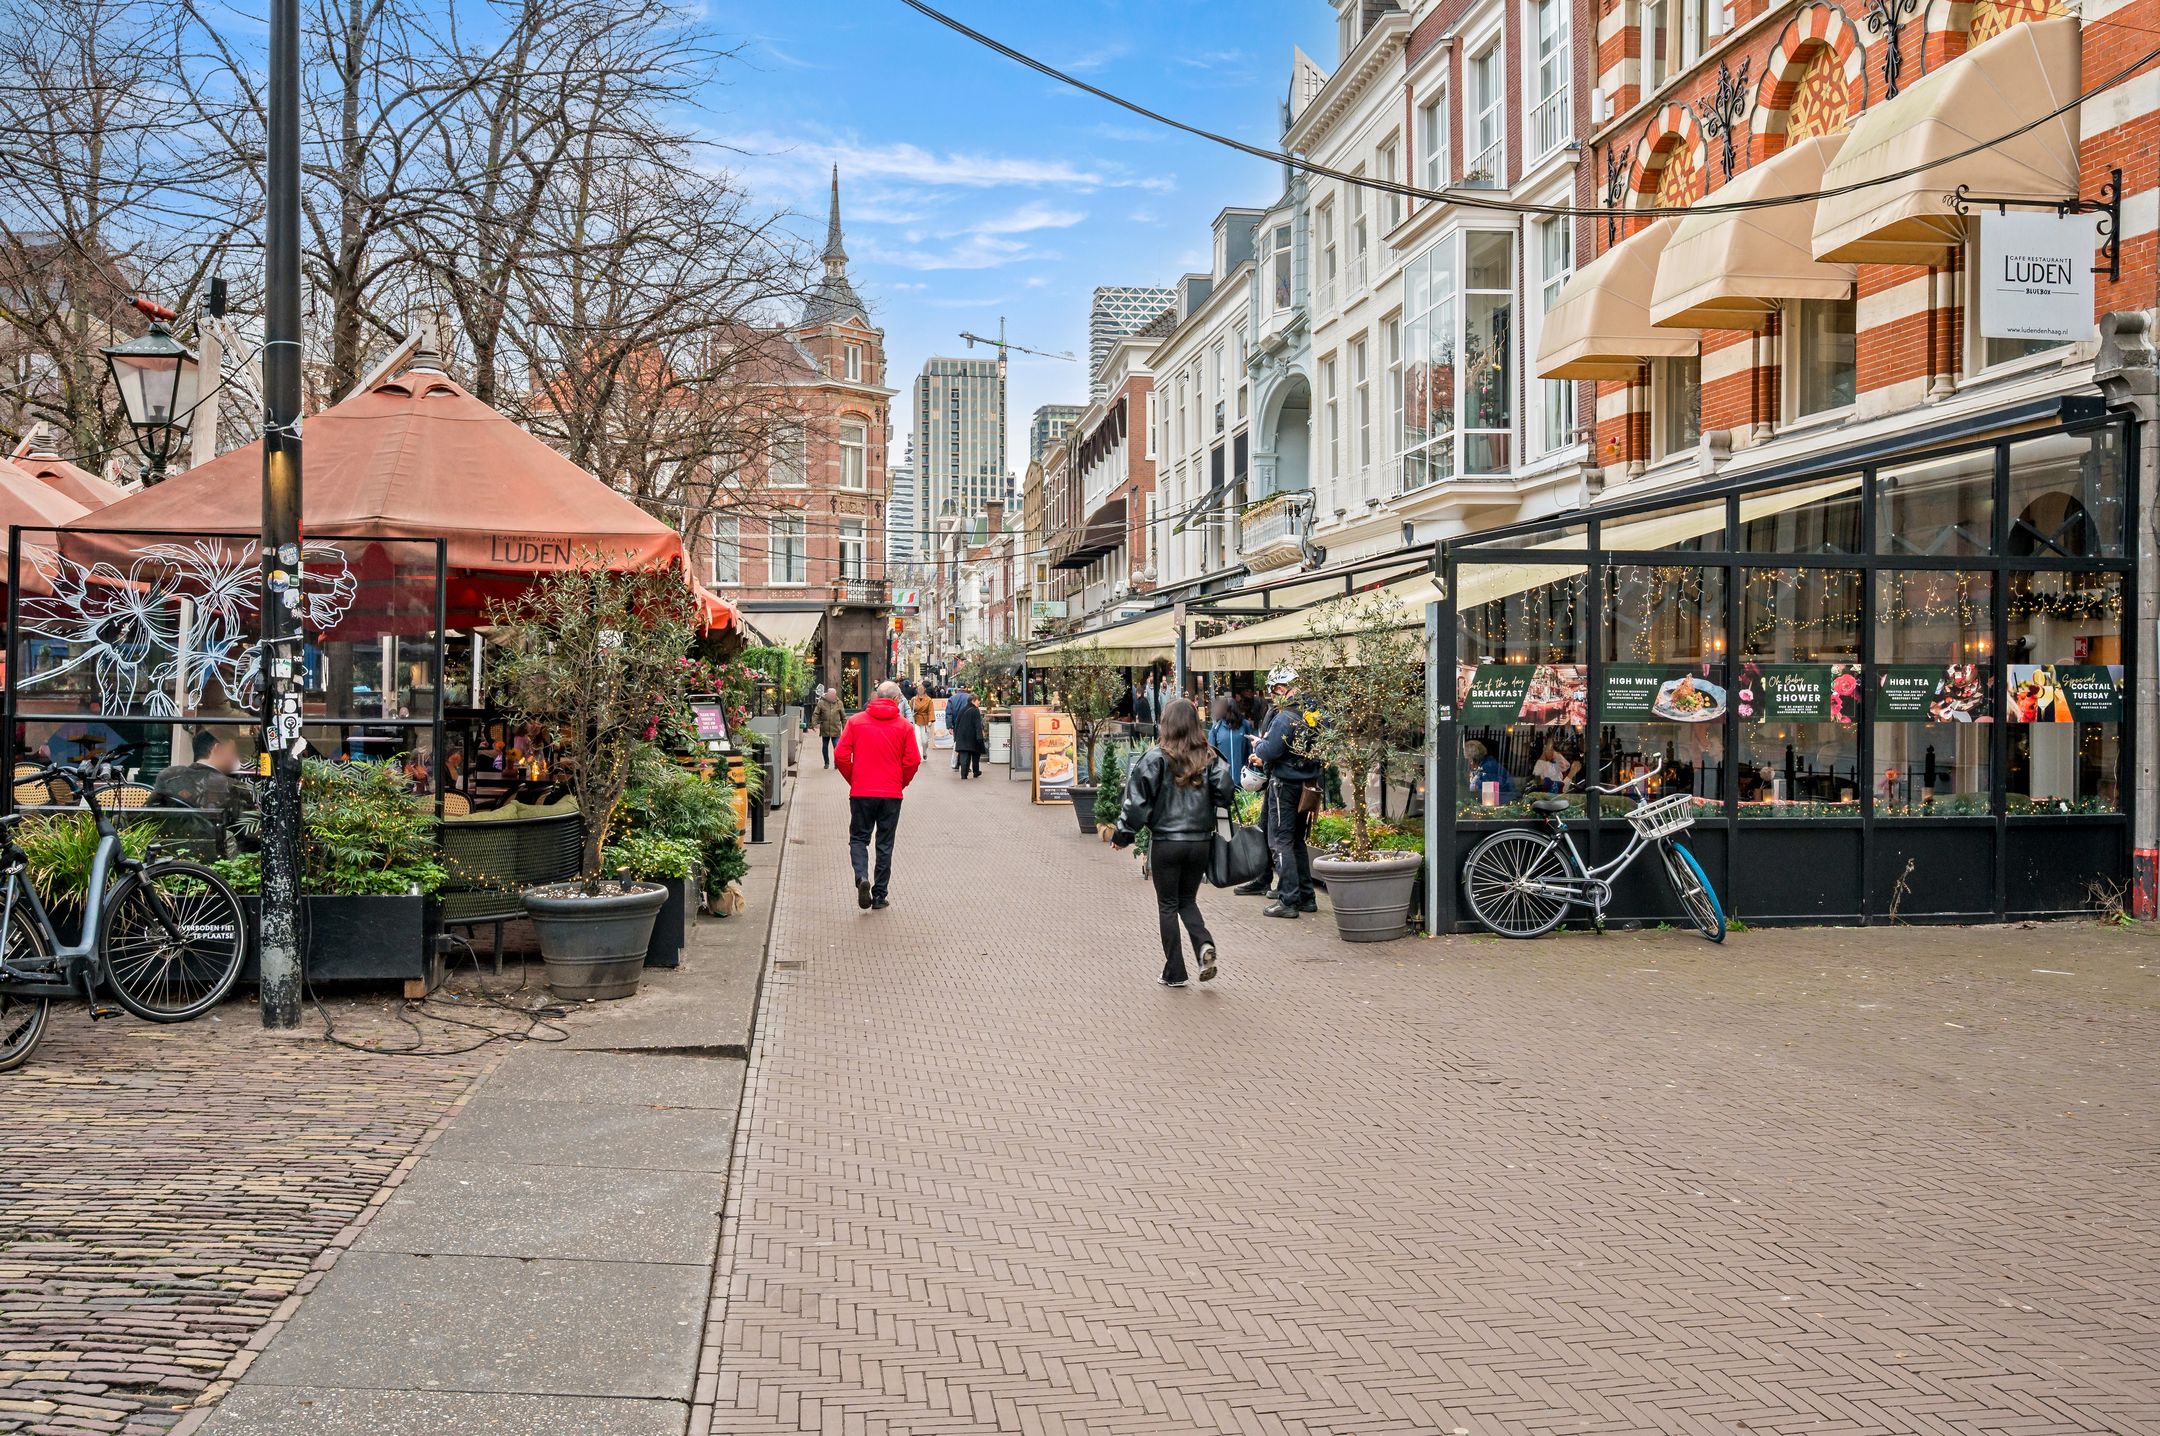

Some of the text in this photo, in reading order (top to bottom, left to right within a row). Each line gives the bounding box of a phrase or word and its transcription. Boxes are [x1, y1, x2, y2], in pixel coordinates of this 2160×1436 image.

[2005, 255, 2072, 284] LUDEN
[2007, 327, 2069, 336] www.ludendenhaag.nl
[492, 534, 571, 564] LUDEN
[1511, 676, 1525, 688] day
[1609, 677, 1632, 685] HIGH
[1784, 673, 1805, 687] Baby
[1889, 678, 1911, 686] HIGH
[1777, 684, 1820, 692] FLOWER
[1472, 690, 1524, 698] BREAKFAST
[1776, 694, 1821, 702] SHOWER
